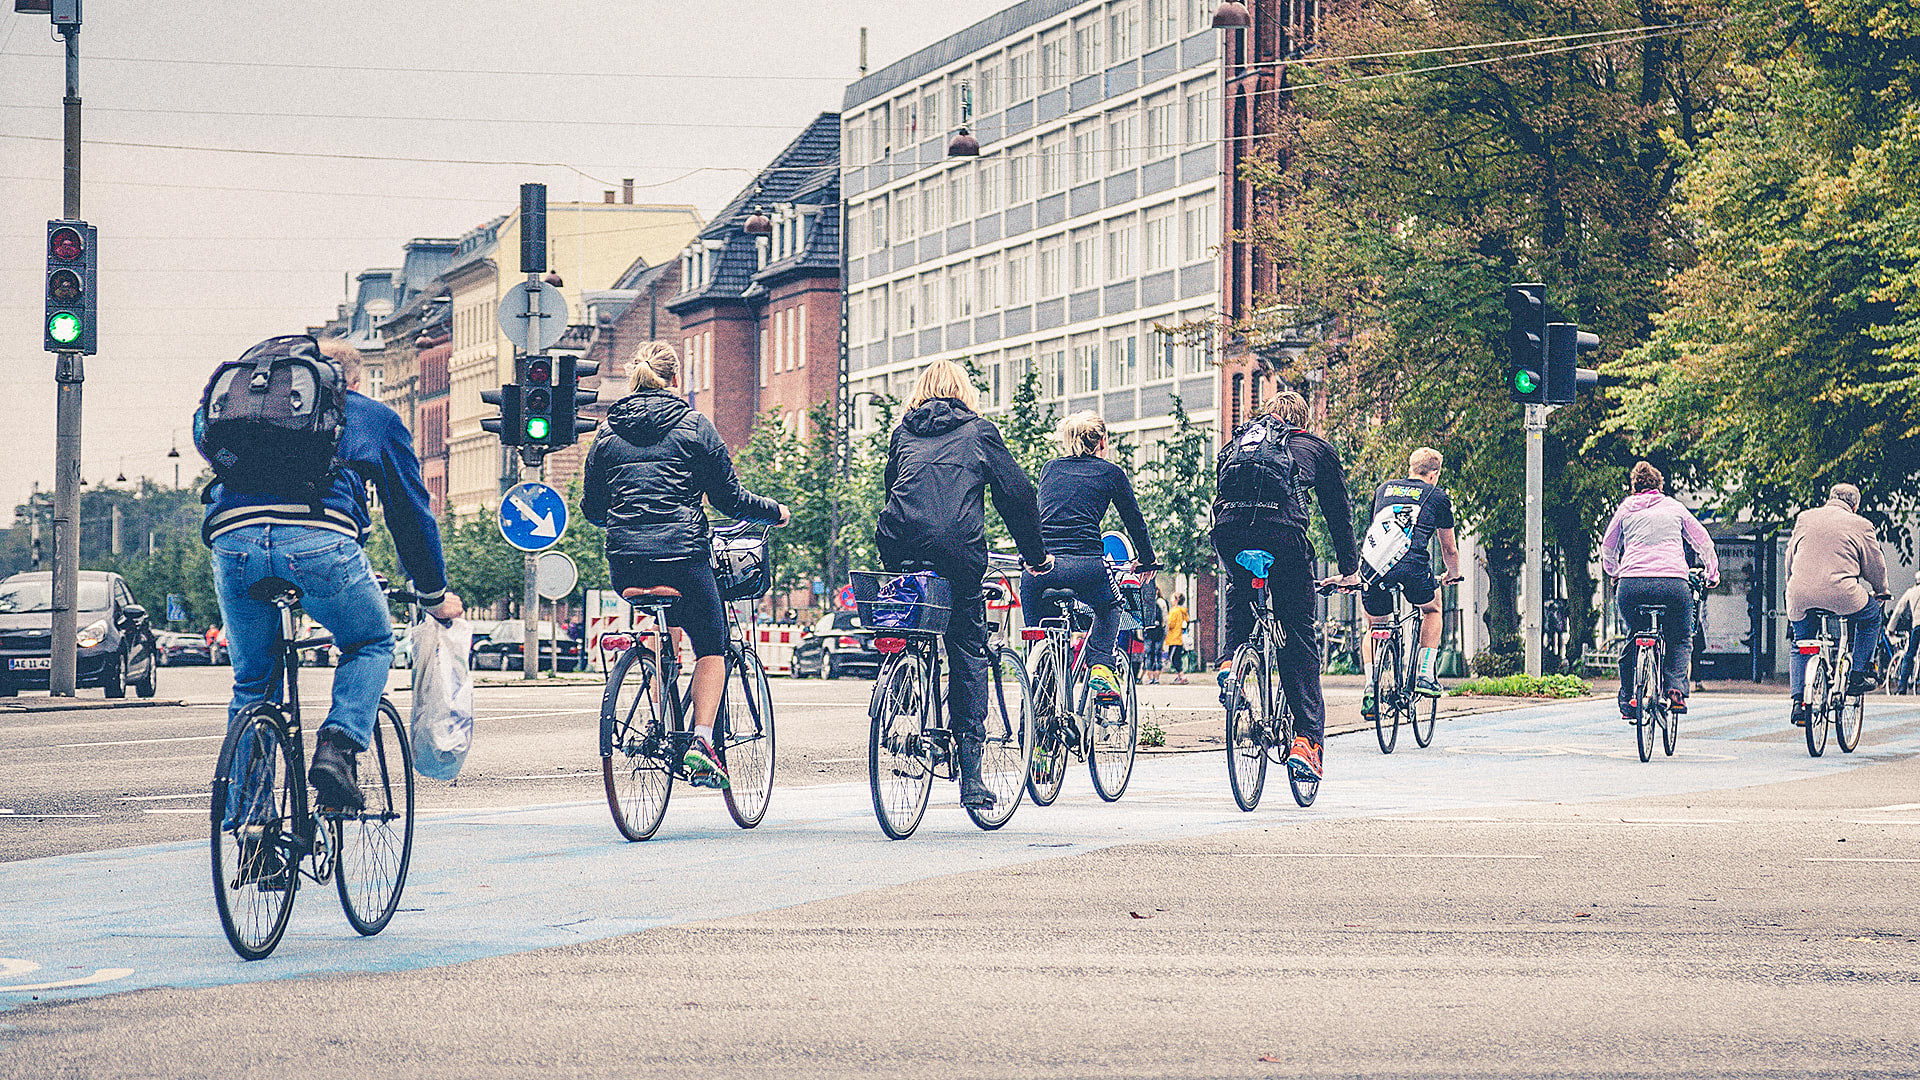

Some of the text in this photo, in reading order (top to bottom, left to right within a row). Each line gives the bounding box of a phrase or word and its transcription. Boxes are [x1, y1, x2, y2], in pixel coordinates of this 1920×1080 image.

[14, 659, 50, 669] AE 11 42
